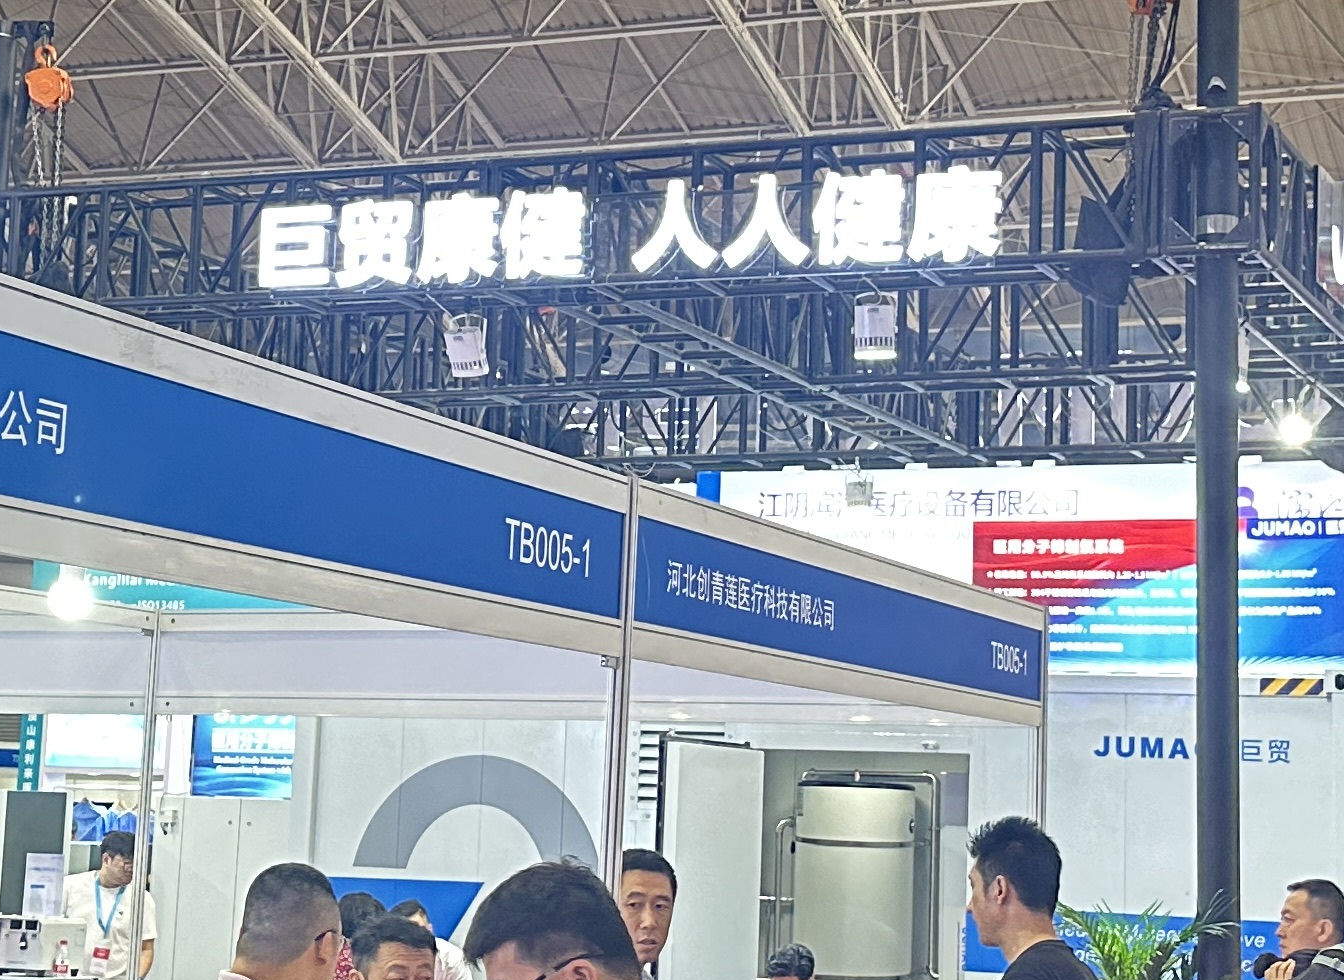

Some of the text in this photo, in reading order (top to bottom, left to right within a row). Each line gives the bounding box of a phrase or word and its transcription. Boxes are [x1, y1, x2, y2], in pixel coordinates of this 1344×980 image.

[257, 165, 1003, 289] 巨贸康健 人人健康
[505, 517, 592, 578] TB005-1
[1251, 520, 1317, 537] JUMAO
[666, 559, 836, 632] 河北创青莲医疗科技有限公司
[990, 641, 1029, 676] TB005-1
[1093, 735, 1291, 764] JUMA 巨贸
